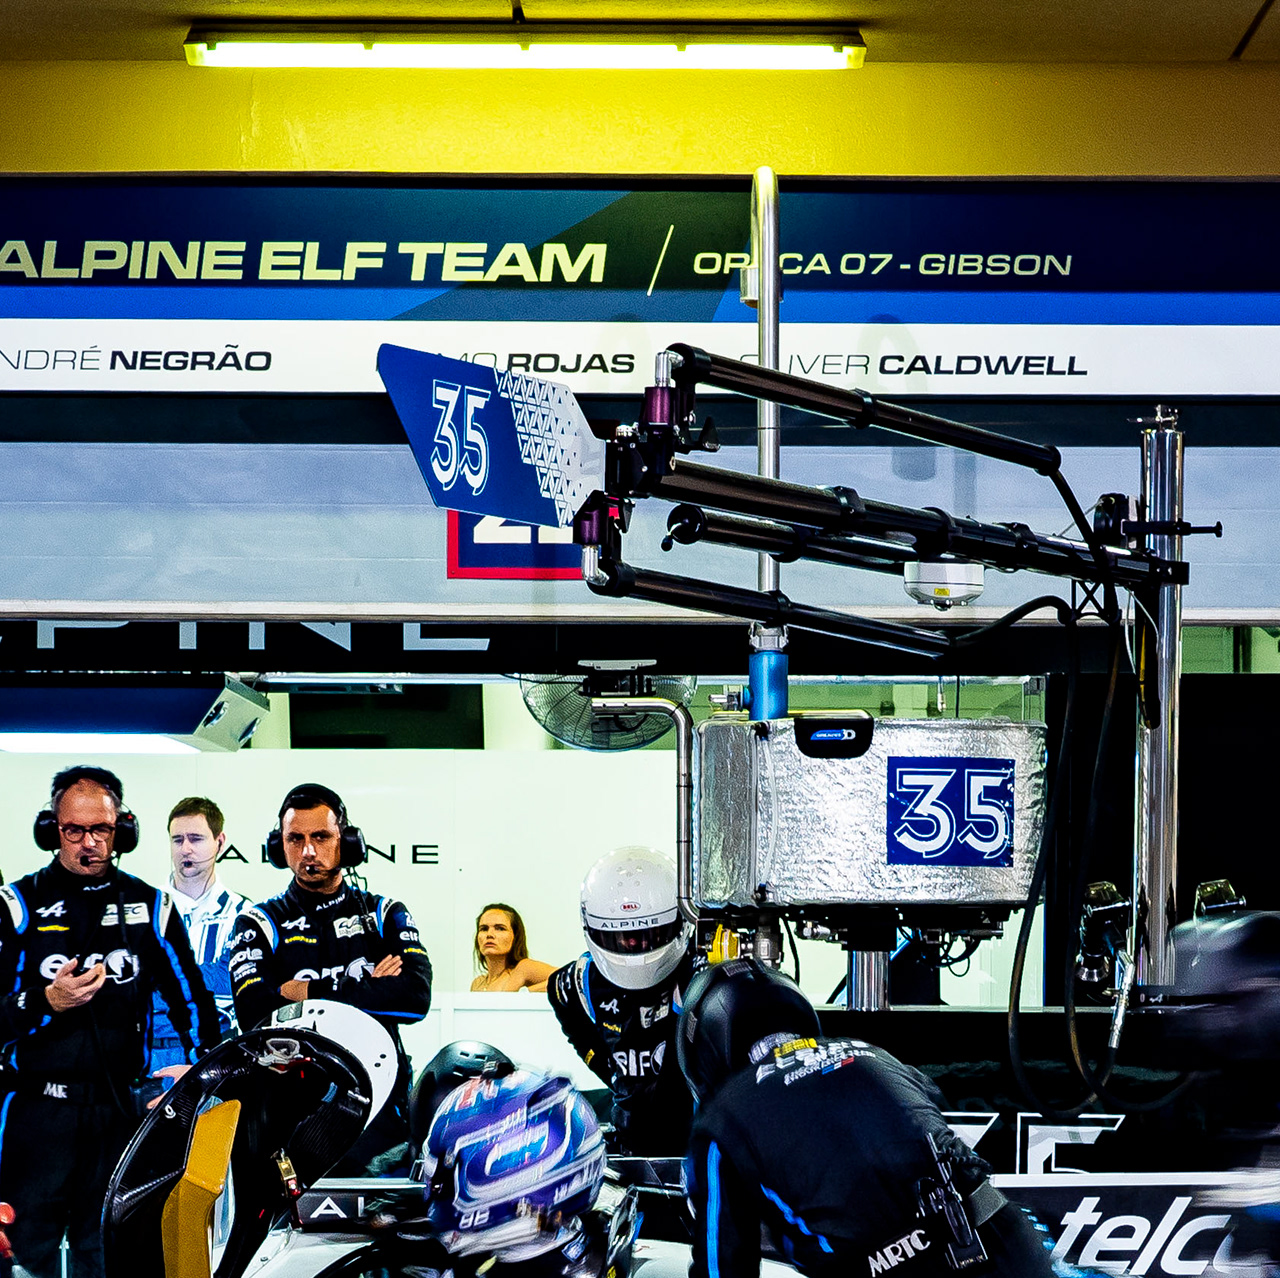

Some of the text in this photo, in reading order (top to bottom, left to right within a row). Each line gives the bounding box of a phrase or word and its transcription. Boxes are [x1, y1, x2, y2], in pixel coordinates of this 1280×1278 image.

[257, 241, 386, 281] ELF
[398, 242, 607, 283] TEAM
[693, 252, 832, 276] ORCA
[839, 253, 893, 275] 07
[918, 254, 1072, 276] GIBSON
[109, 344, 273, 372] NEGRÃO
[507, 353, 635, 374] ROJAS
[878, 355, 1089, 377] CALDWELL
[430, 379, 492, 496] 35
[893, 767, 1012, 860] 35
[600, 917, 660, 929] ALPINE
[867, 1229, 931, 1278] MRTC
